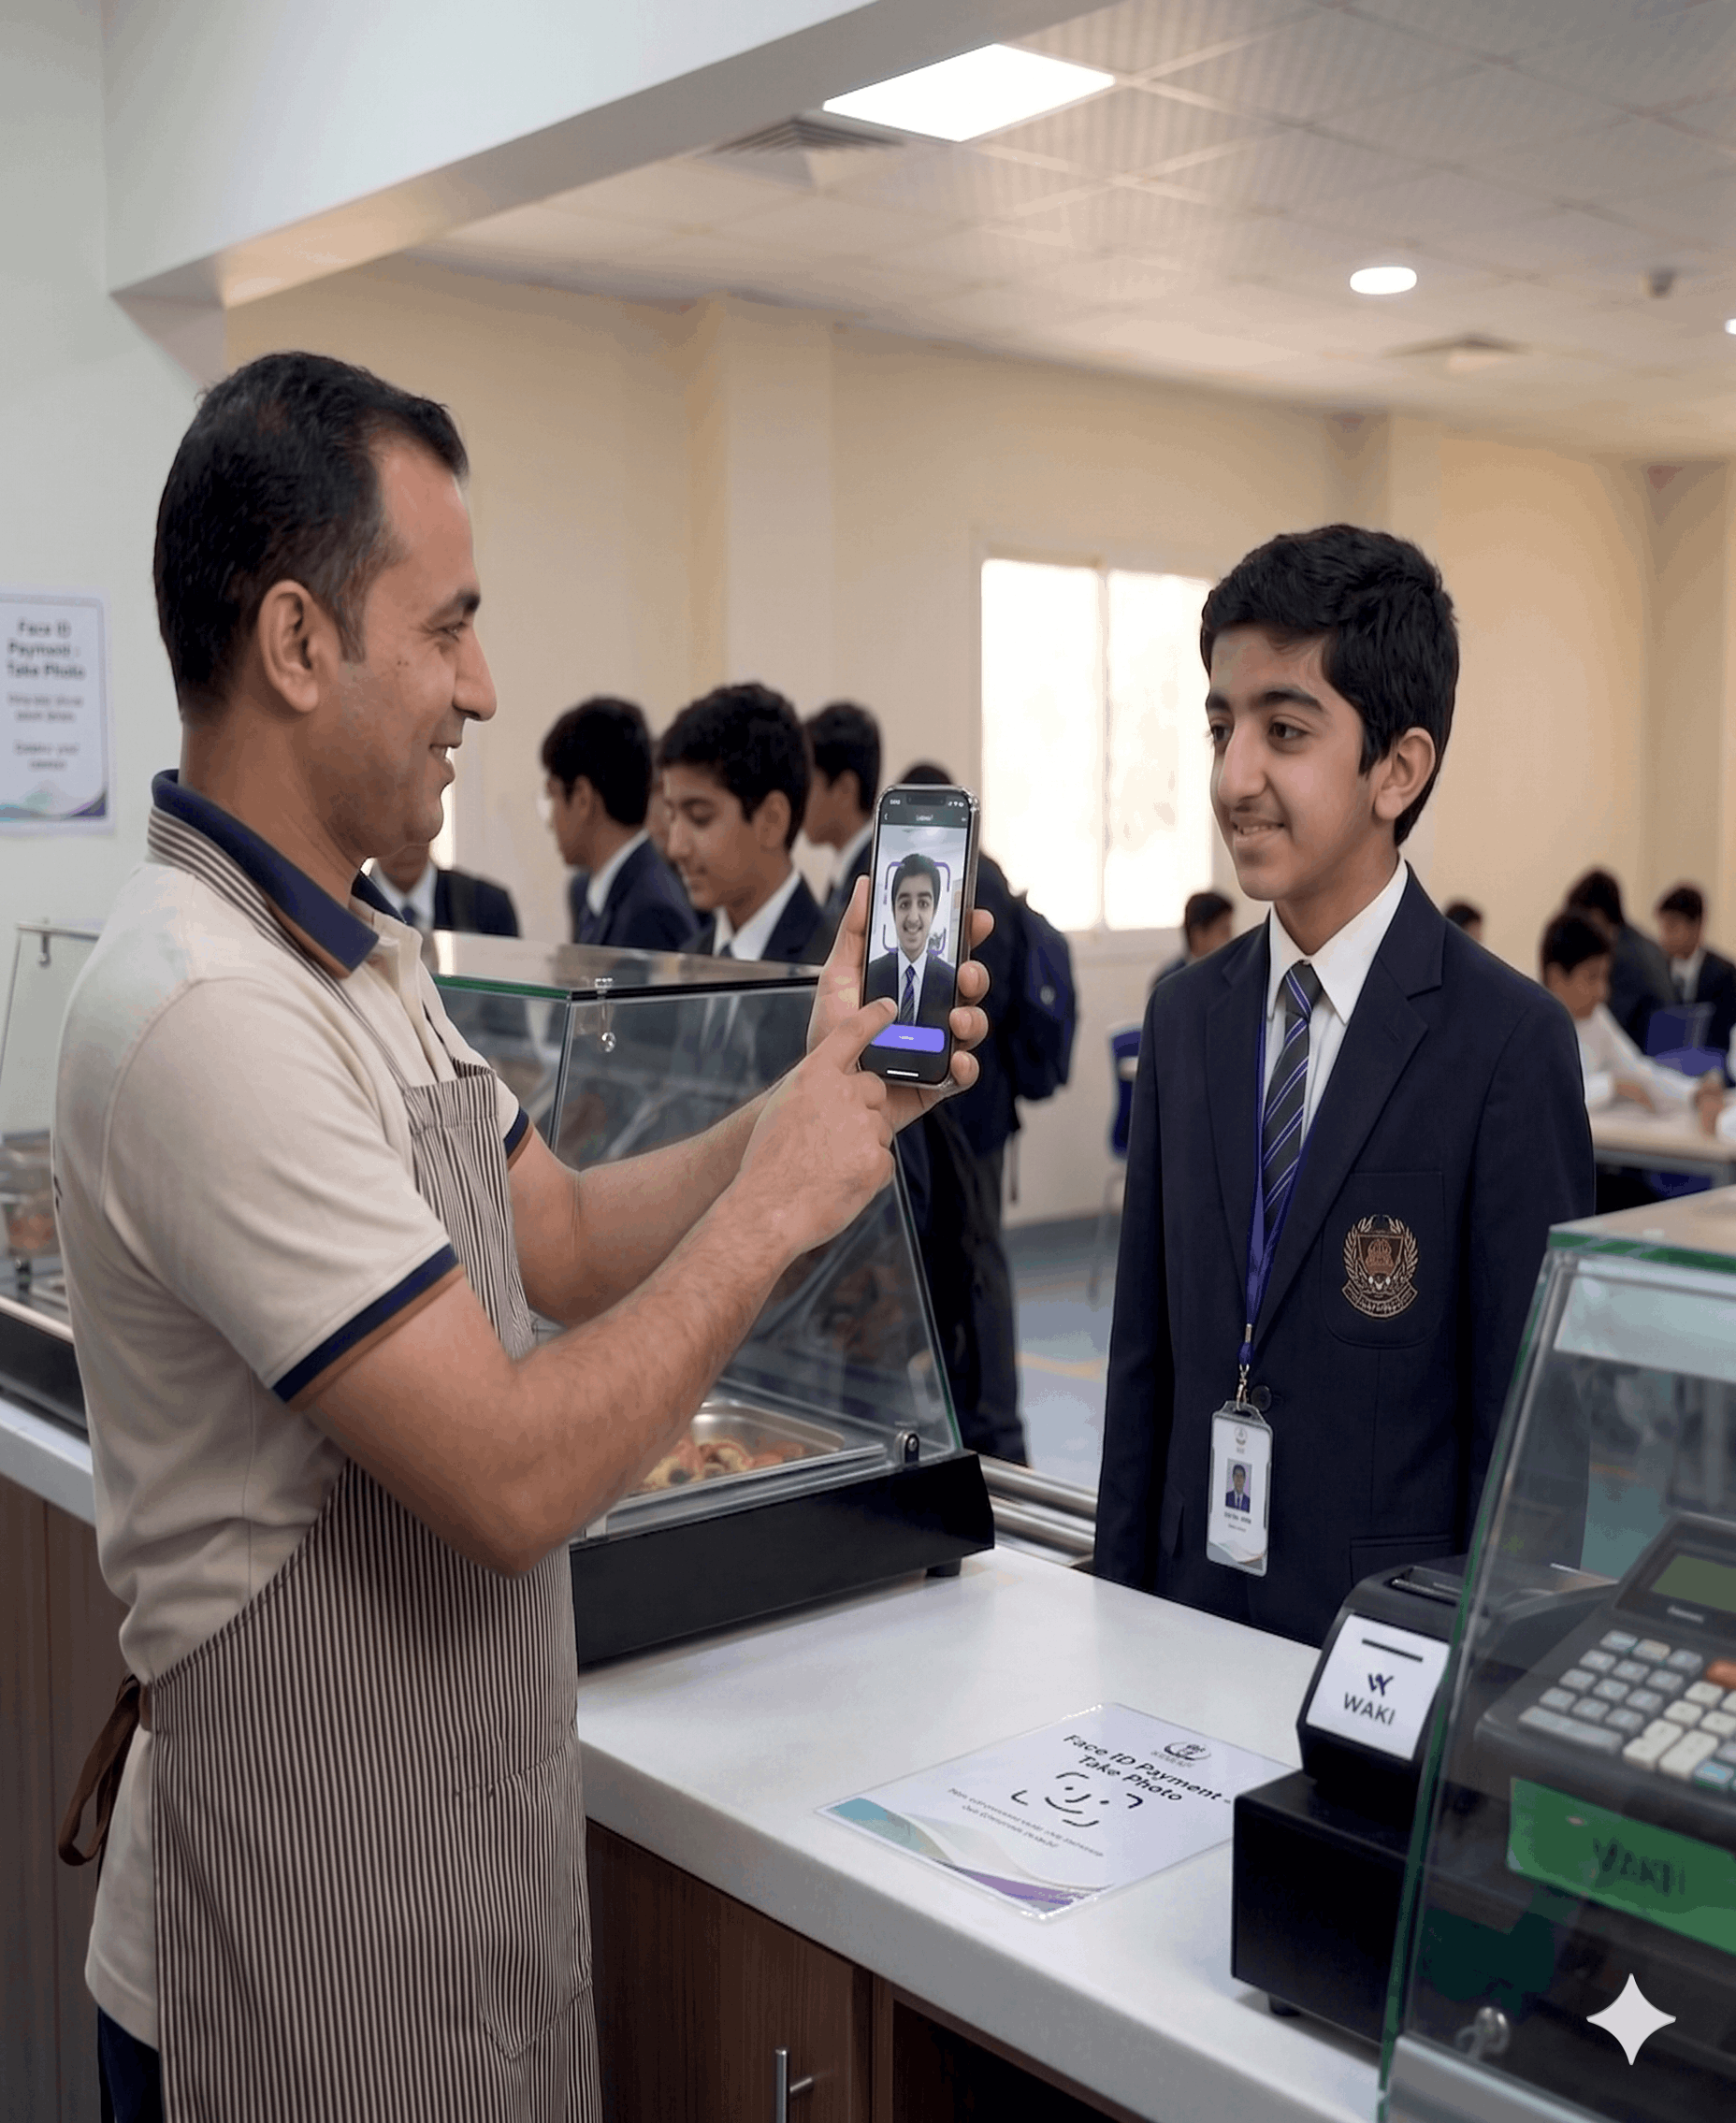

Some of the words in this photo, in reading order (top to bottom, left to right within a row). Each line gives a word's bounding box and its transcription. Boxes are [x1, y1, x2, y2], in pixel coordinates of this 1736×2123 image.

[1344, 1692, 1396, 1726] WAKI
[1063, 1734, 1108, 1755] Face
[1109, 1753, 1136, 1766] ID
[1135, 1763, 1222, 1800] Payment
[1078, 1755, 1121, 1776] Take
[1122, 1773, 1183, 1801] Photo
